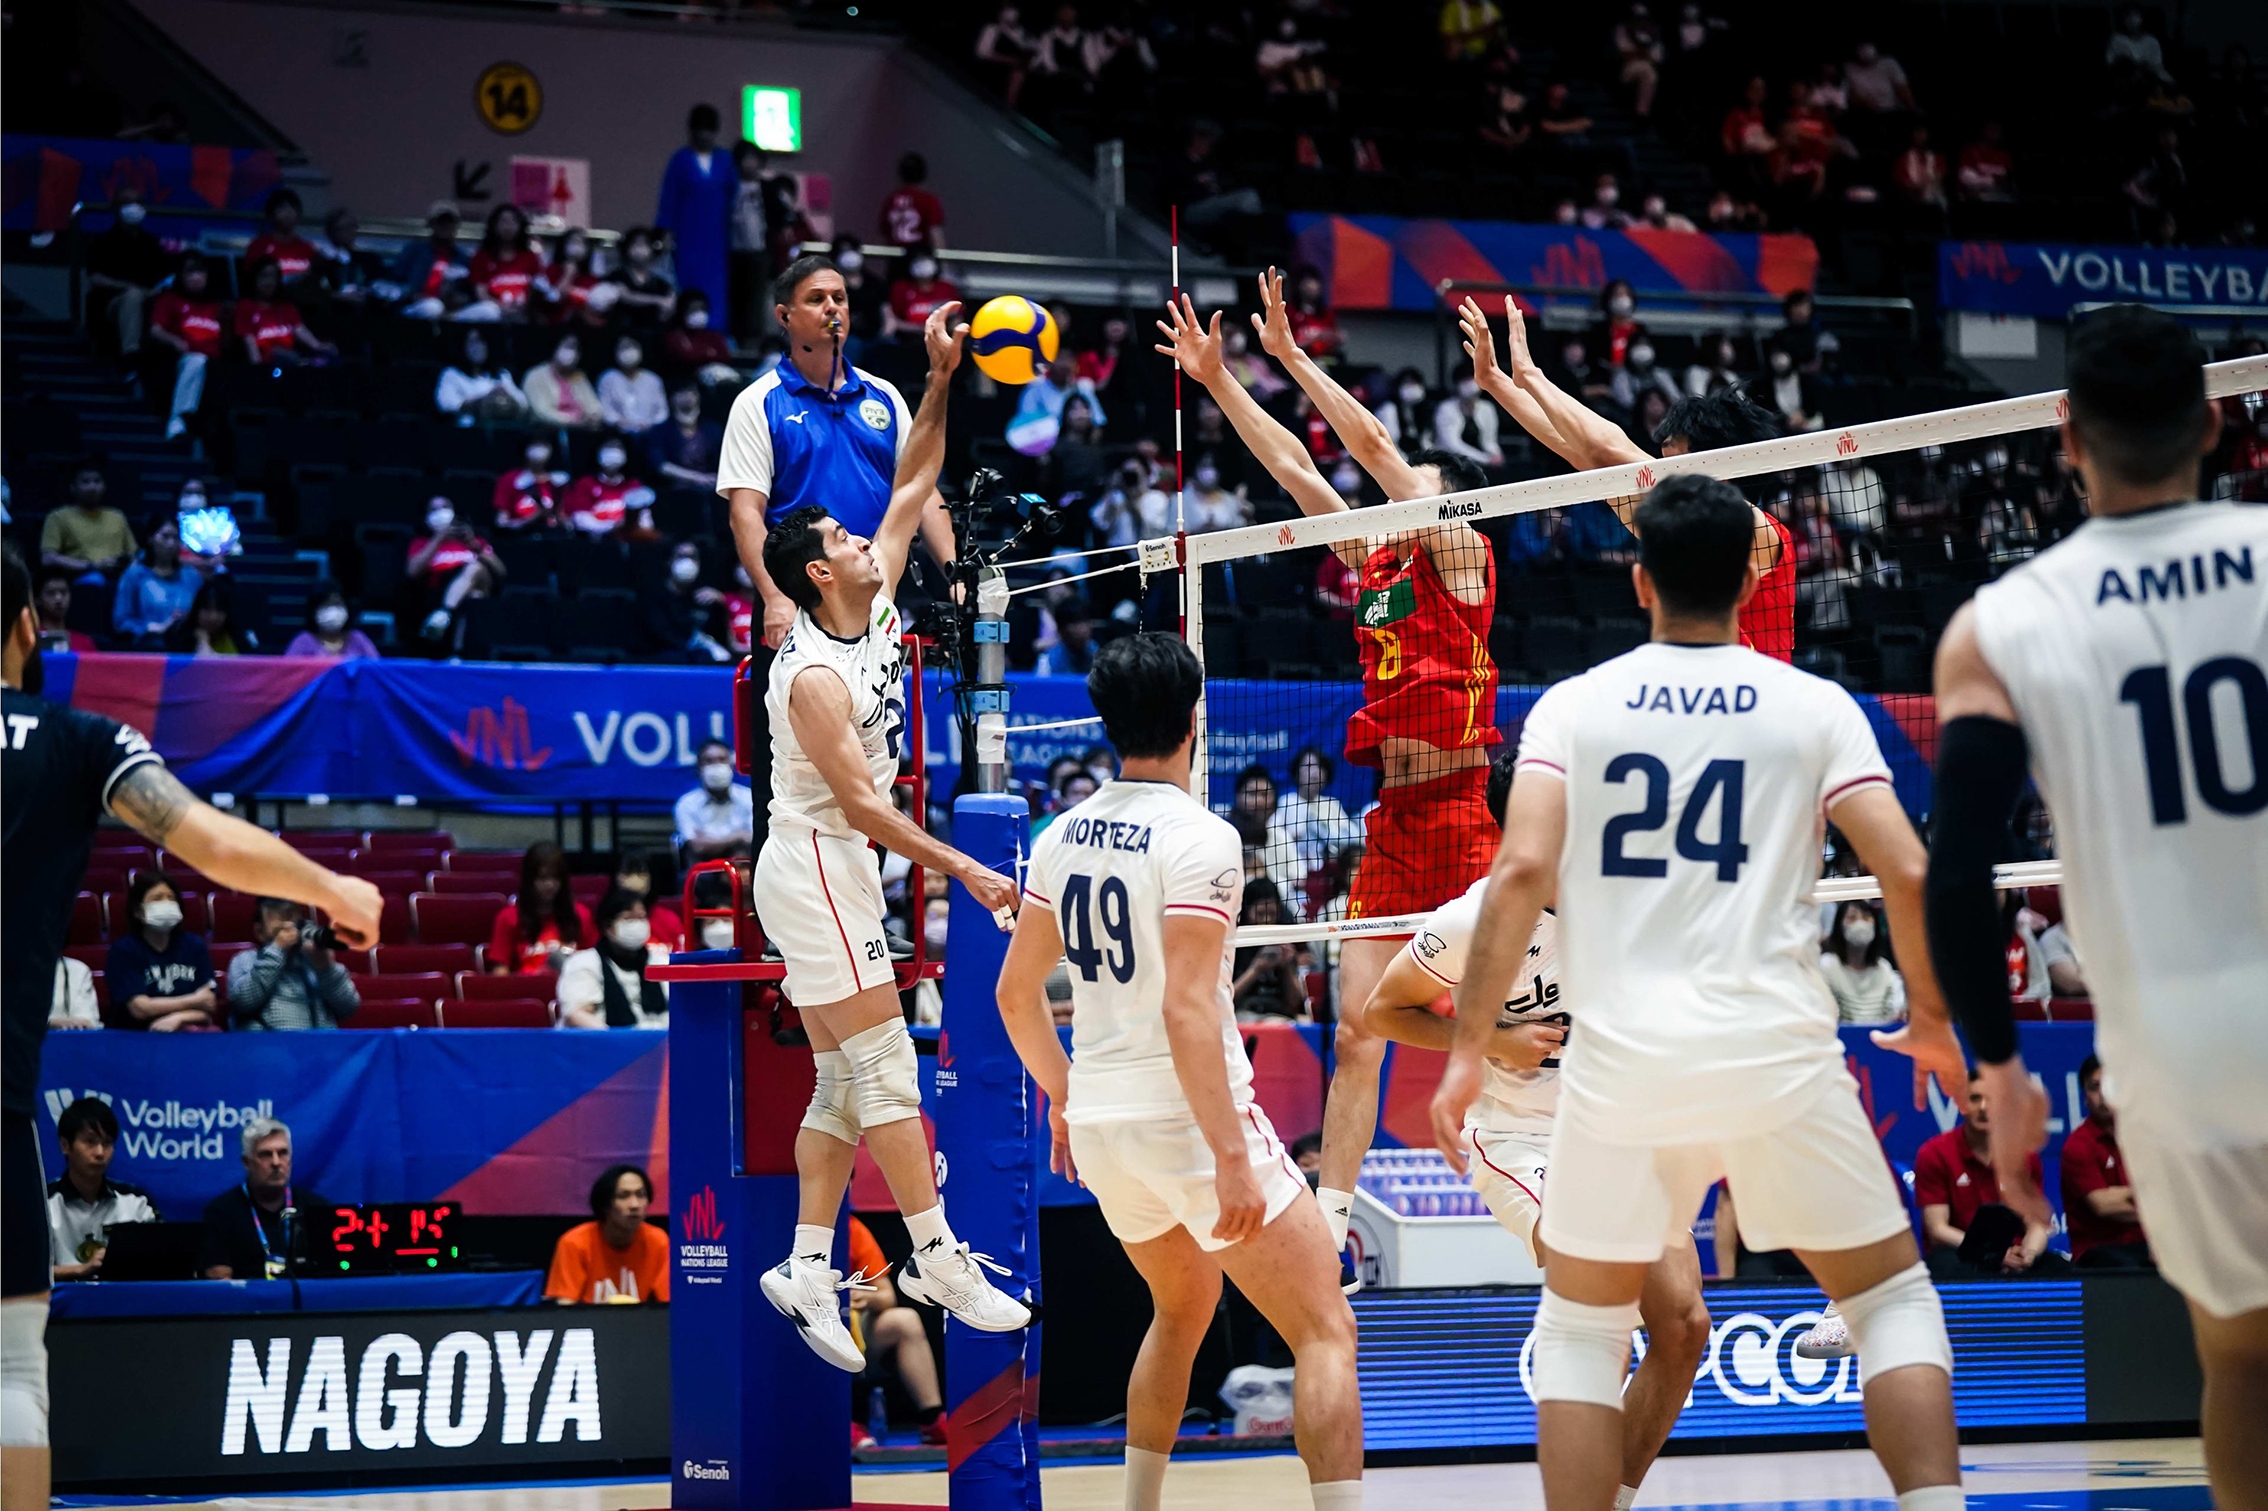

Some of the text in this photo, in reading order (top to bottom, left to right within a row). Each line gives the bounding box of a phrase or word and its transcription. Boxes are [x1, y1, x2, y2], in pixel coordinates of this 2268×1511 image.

[487, 84, 528, 121] 14
[2037, 248, 2268, 303] VOLLEYB
[1438, 499, 1483, 520] MIKASA
[2097, 546, 2254, 606] AMIN
[1626, 684, 1759, 715] JAVAD
[2119, 656, 2268, 826] 10
[1062, 817, 1152, 855] MORTEZA
[1601, 752, 1749, 884] 24
[1061, 873, 1136, 985] 49
[865, 939, 884, 961] 20
[122, 1099, 273, 1135] Volleyball
[122, 1130, 223, 1160] World
[680, 1245, 728, 1257] VOLLEYBALL
[681, 1258, 728, 1267] NATIONS LEAGUE
[220, 1328, 602, 1455] NAGOYA
[694, 1464, 730, 1480] Senoh
